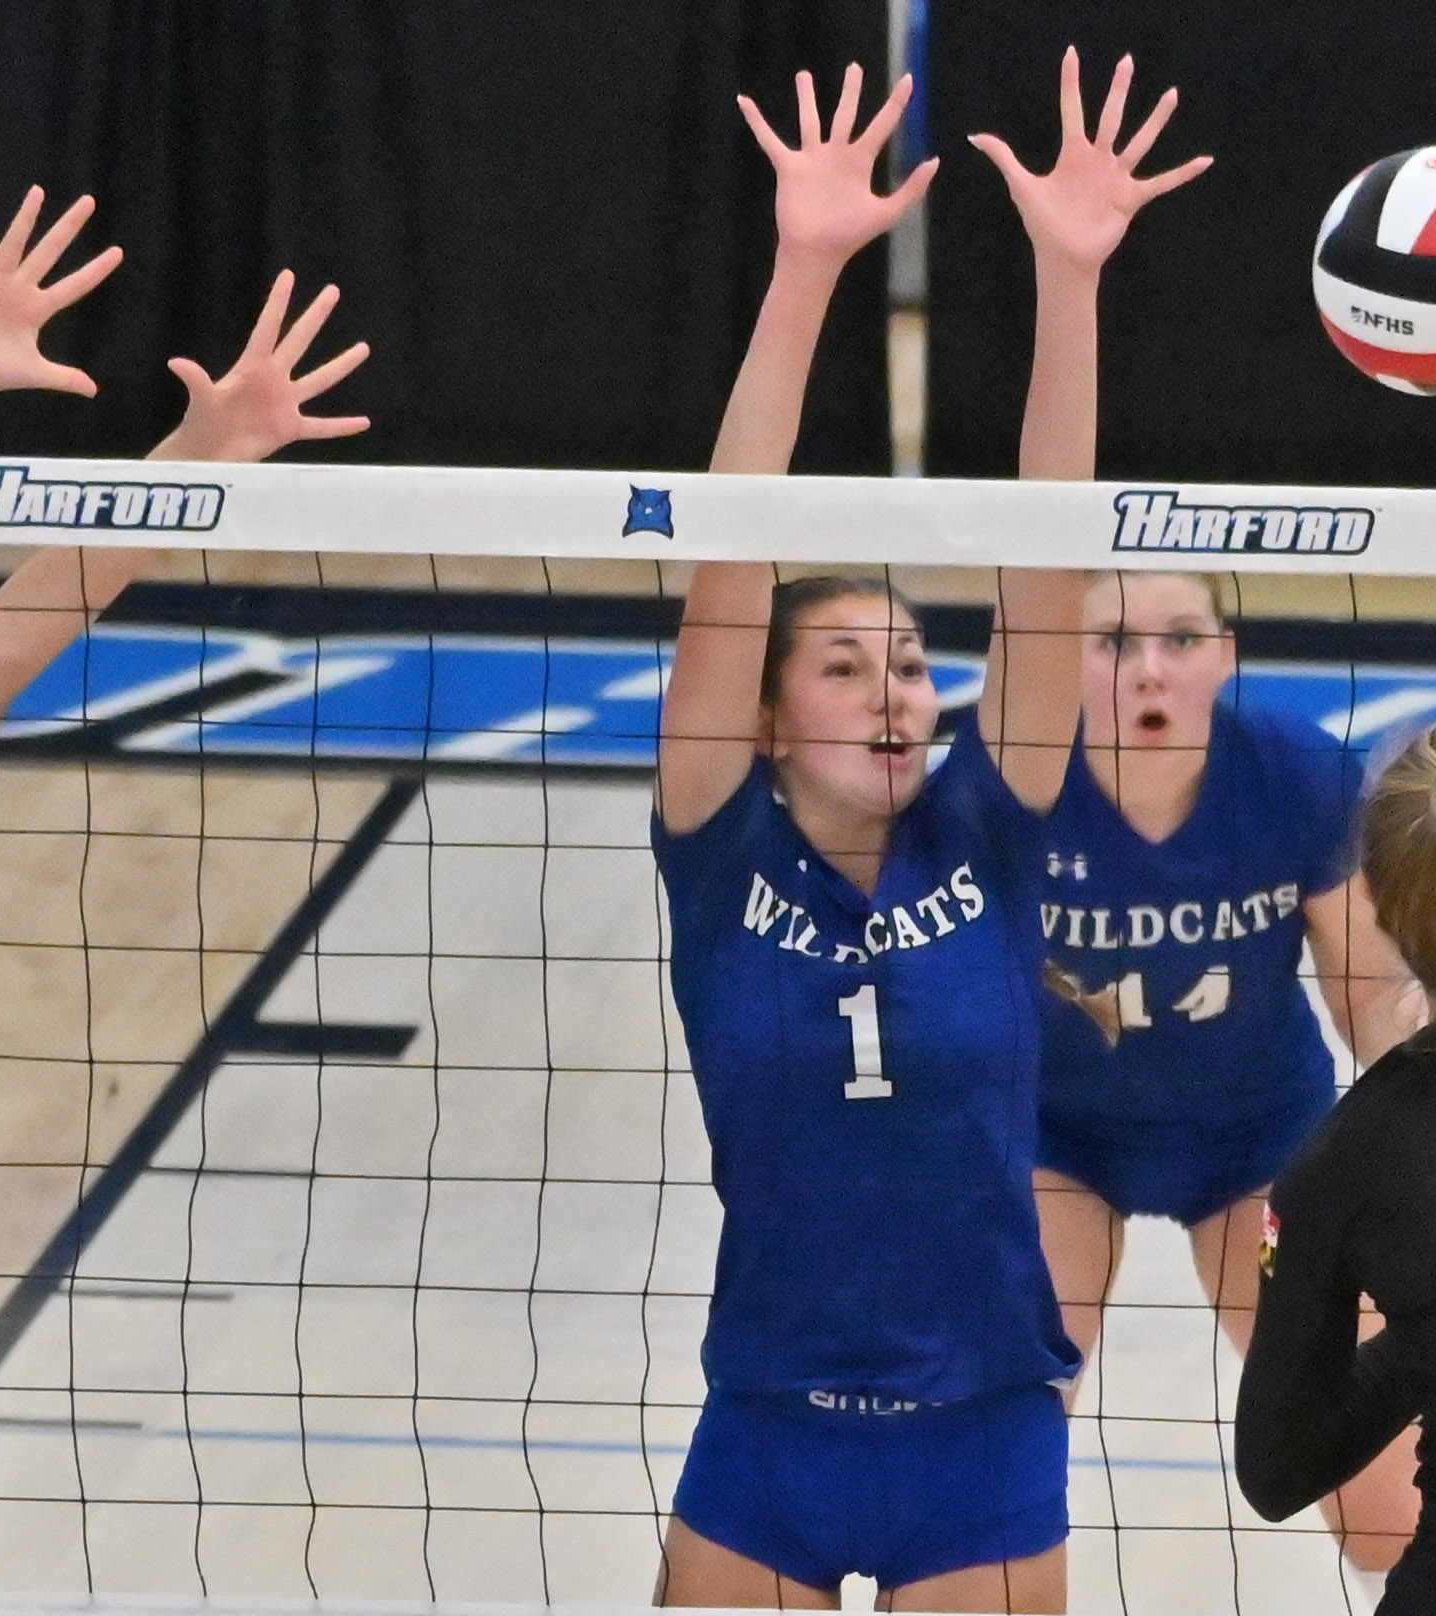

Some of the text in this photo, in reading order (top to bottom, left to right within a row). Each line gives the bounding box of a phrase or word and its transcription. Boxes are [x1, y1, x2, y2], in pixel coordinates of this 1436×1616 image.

[1363, 309, 1415, 336] NFHS
[1111, 490, 1376, 556] HARFORD
[838, 985, 893, 1100] 1
